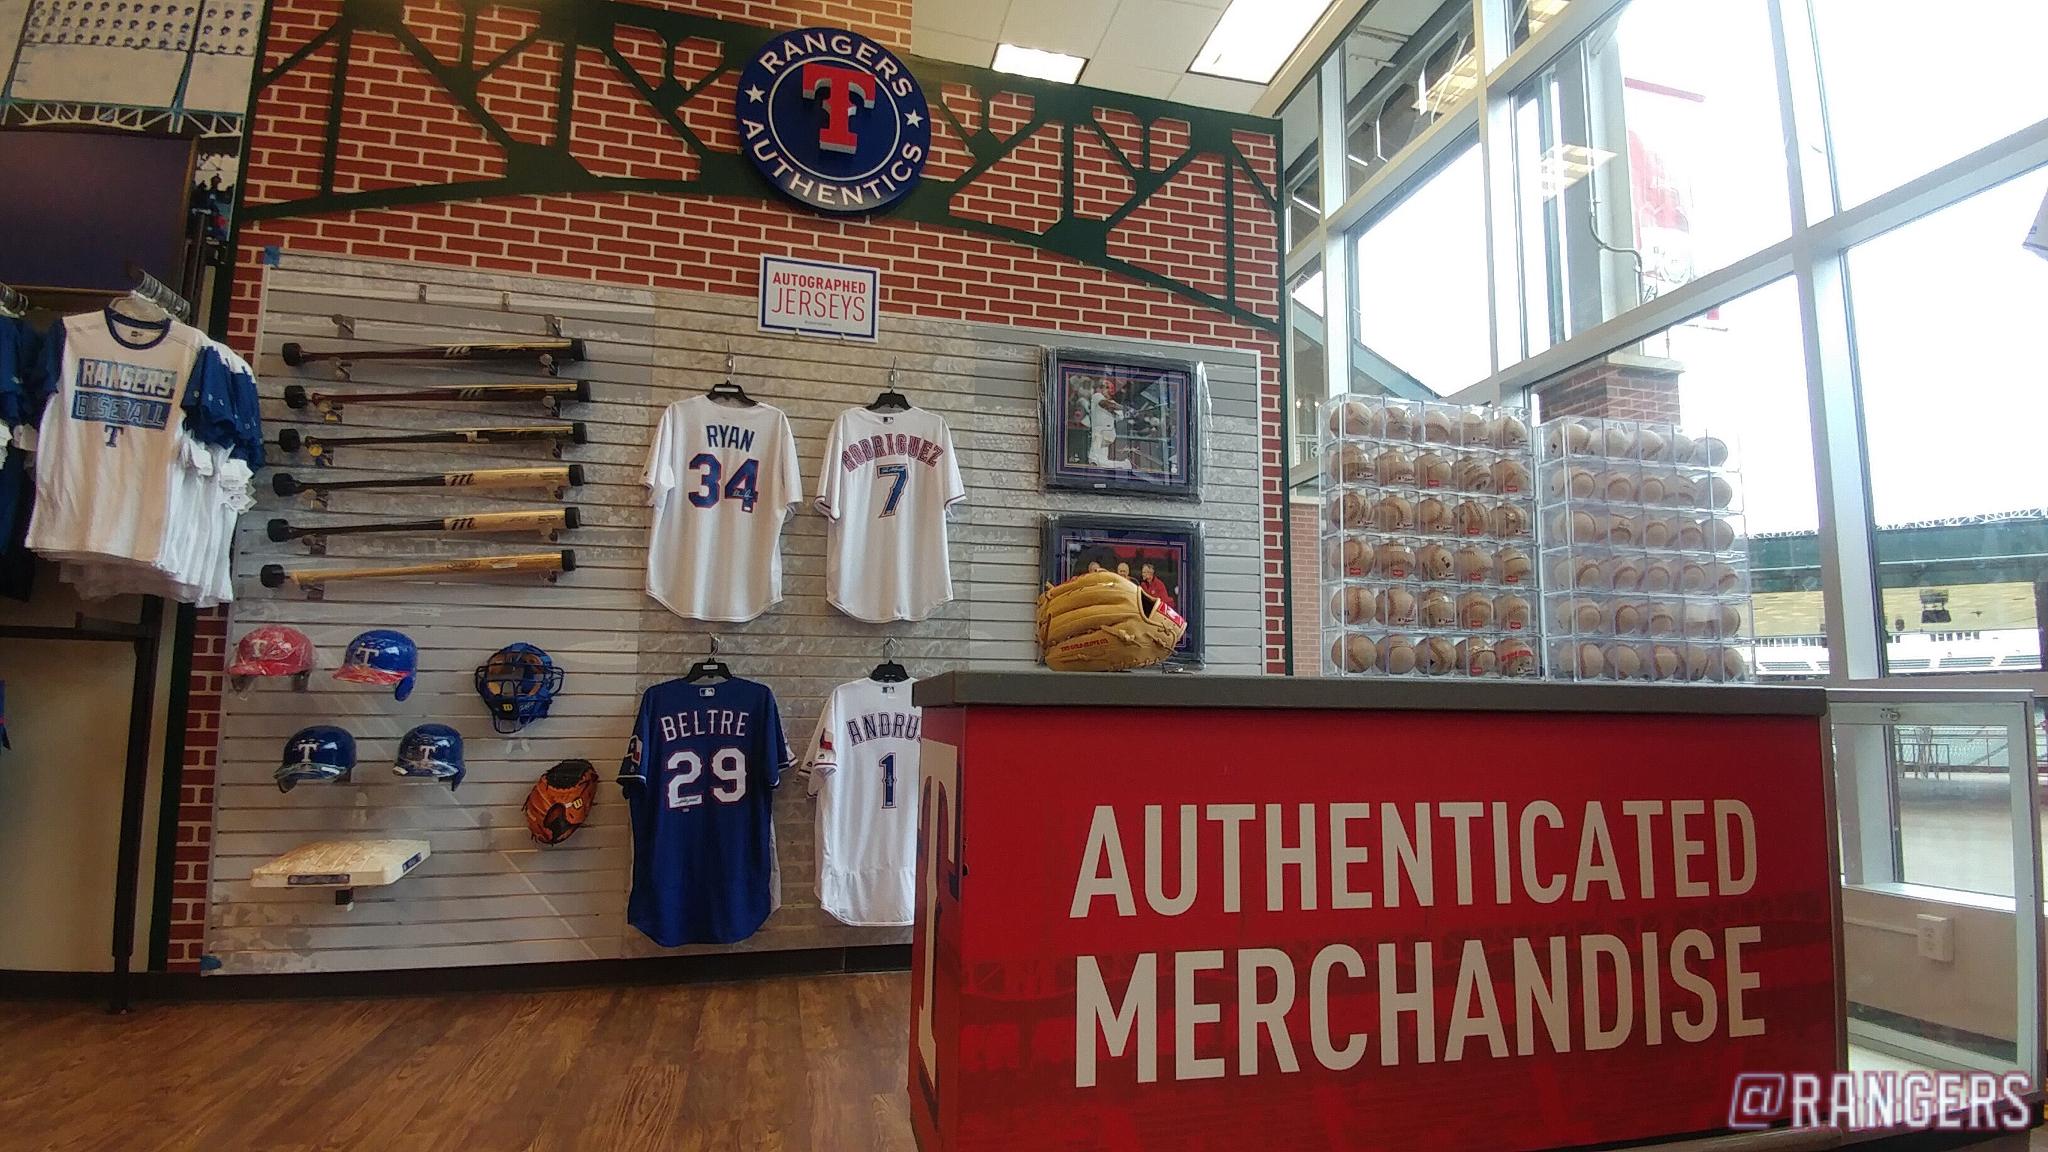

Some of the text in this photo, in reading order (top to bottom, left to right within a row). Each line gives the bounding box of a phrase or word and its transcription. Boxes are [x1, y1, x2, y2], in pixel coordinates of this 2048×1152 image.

[758, 32, 913, 97] RANGERS
[802, 62, 877, 155] T
[742, 118, 922, 206] AUTHENTICS
[772, 271, 866, 295] AUTOGRAPHED
[771, 287, 865, 322] JERSEYS
[82, 359, 174, 397] RANGERS
[104, 425, 124, 448] T
[705, 424, 755, 453] RYAN
[841, 433, 944, 473] RODRIGUEZ
[688, 453, 759, 514] 34
[876, 463, 909, 519] 7
[356, 646, 380, 666] T
[660, 709, 750, 742] BELTRE
[846, 711, 922, 747] ANDRU
[298, 743, 319, 763] T
[419, 745, 436, 761] T
[666, 747, 748, 809] 29
[878, 752, 898, 810] 1
[1068, 799, 1759, 918] AUTHENTICATED
[1075, 926, 1766, 1088] MERCHANDISE
